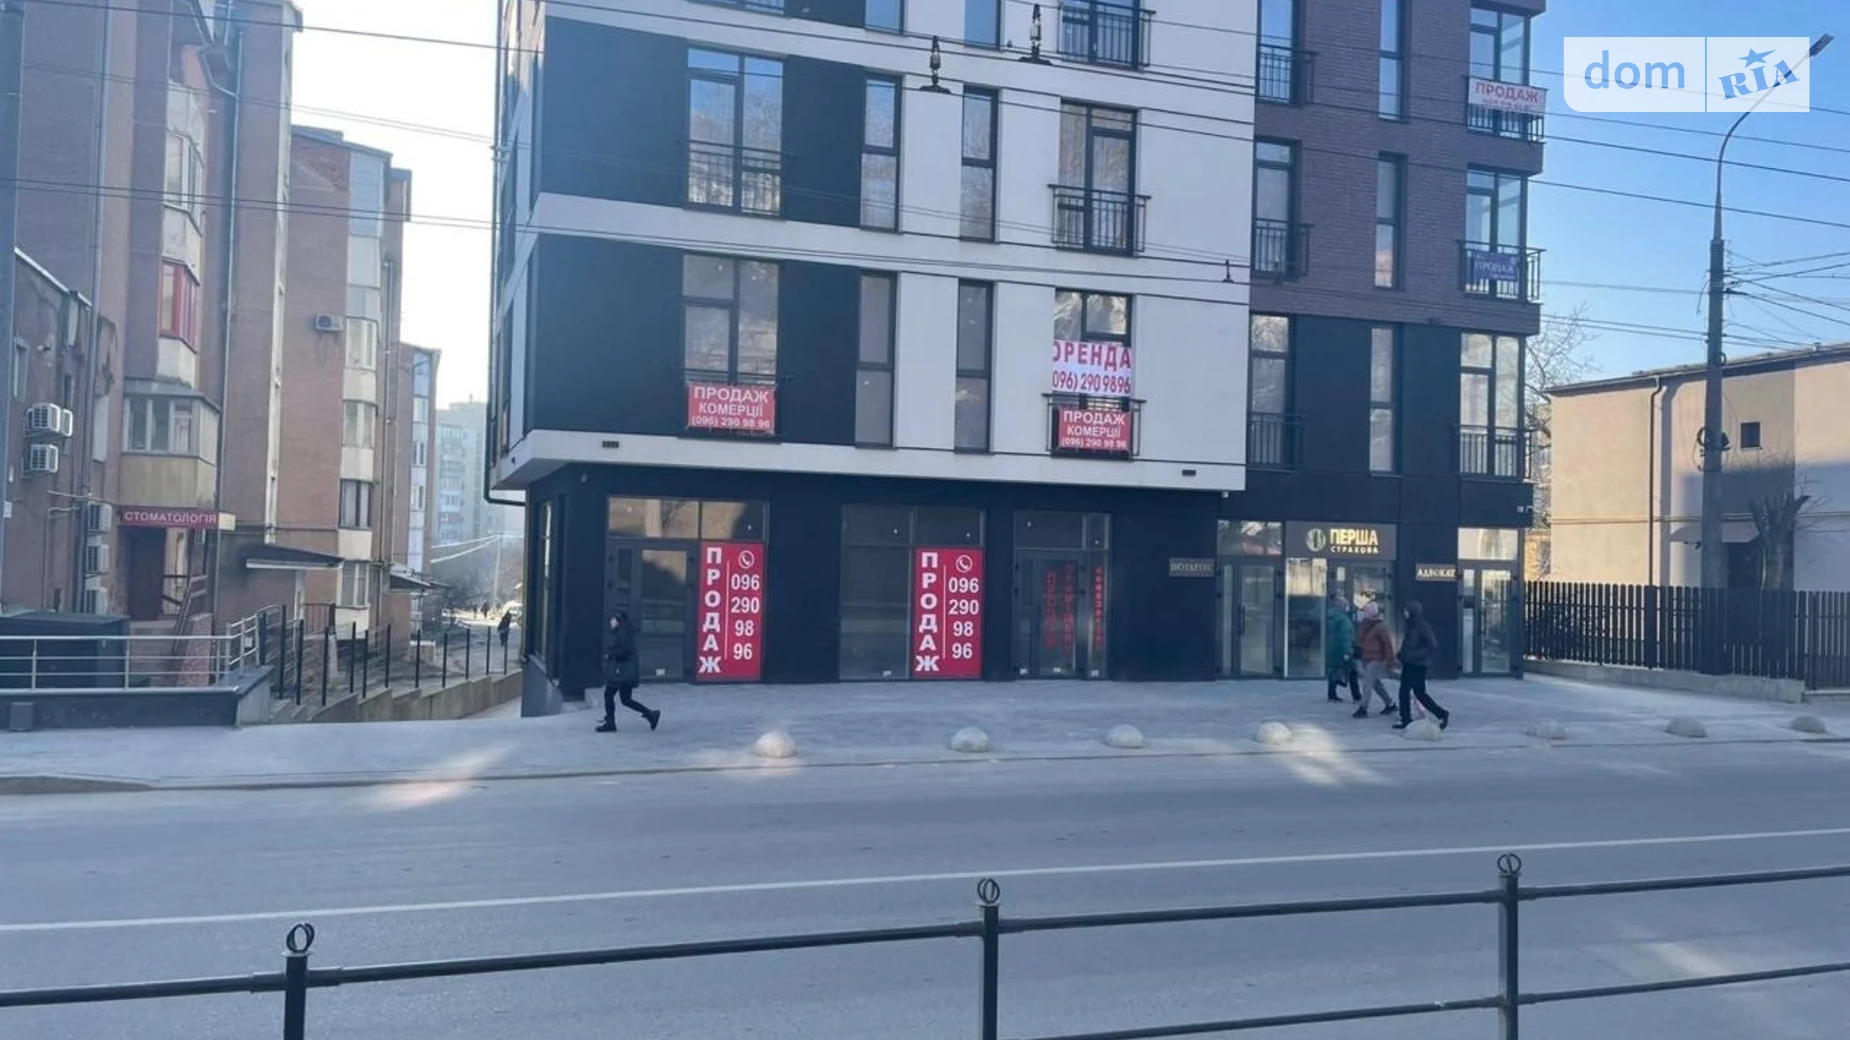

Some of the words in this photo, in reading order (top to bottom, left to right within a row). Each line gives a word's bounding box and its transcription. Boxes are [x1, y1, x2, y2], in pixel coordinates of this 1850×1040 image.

[1475, 81, 1539, 104] ПРОДАЖ
[694, 386, 769, 403] ПРОДАЖ
[699, 402, 763, 417] КОМЕРЦІЇ
[1063, 411, 1126, 425] ПРОДАЖ
[692, 415, 718, 427] (096)
[720, 417, 740, 427] 290
[741, 418, 755, 428] 98
[756, 419, 770, 429] 96
[1067, 424, 1121, 439] КОМЕРЦІЇ
[1061, 437, 1084, 447] (096)
[1085, 438, 1102, 448] 290
[124, 511, 216, 524] СТОМАТОЛОГІЯ
[1330, 528, 1379, 546] ПЕРША
[1330, 546, 1379, 554] СТРАХОВА
[1417, 568, 1456, 578] АДВОКАТ
[731, 574, 760, 591] 096
[948, 577, 979, 594] 096
[698, 547, 723, 673] ПРОДАЖ
[731, 597, 760, 614] 290
[915, 552, 940, 672] ПРОДАЖ
[948, 599, 979, 616] 290
[735, 620, 754, 637] 98
[953, 621, 974, 637] 98
[733, 643, 753, 660] 96
[951, 642, 973, 659] 96
